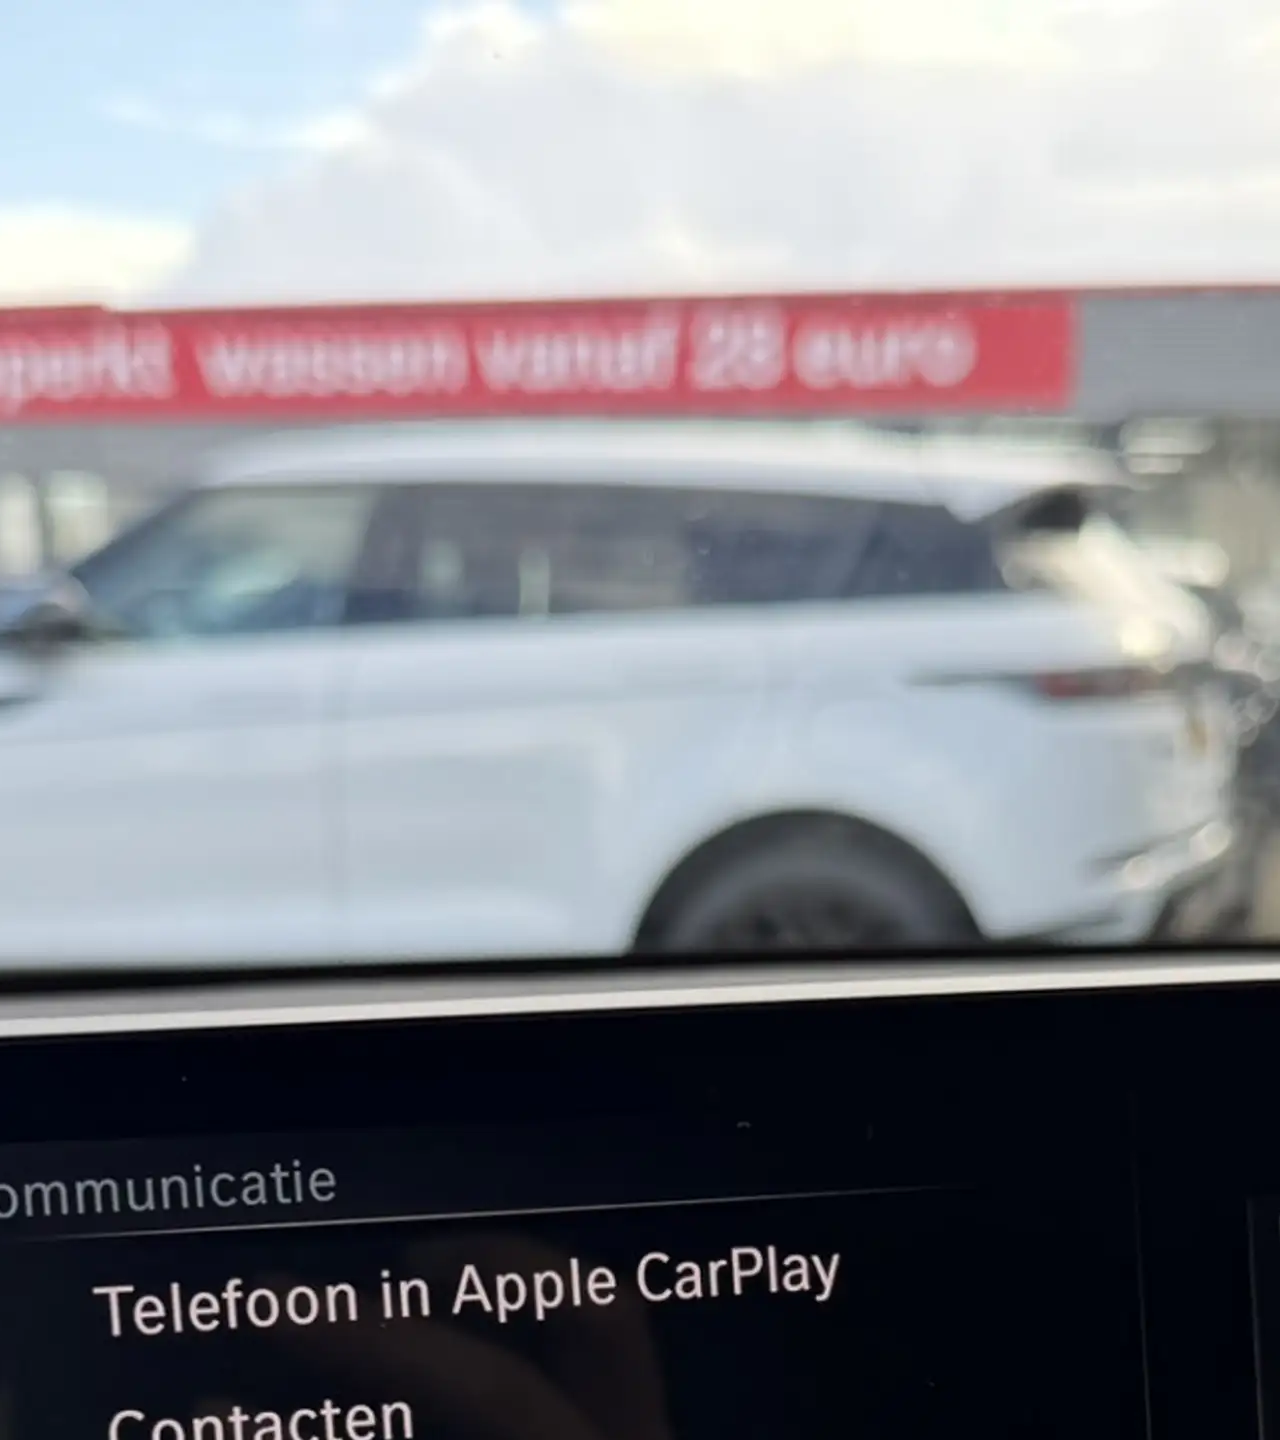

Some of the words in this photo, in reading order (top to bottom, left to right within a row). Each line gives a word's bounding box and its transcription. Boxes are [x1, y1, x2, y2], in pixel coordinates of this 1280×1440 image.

[198, 326, 466, 399] wassen
[476, 305, 681, 392] vanaf
[792, 314, 977, 388] euro
[91, 1277, 358, 1337] Telefoon
[380, 1268, 430, 1319] in
[451, 1256, 617, 1324] Apple
[636, 1244, 840, 1302] CarPlay
